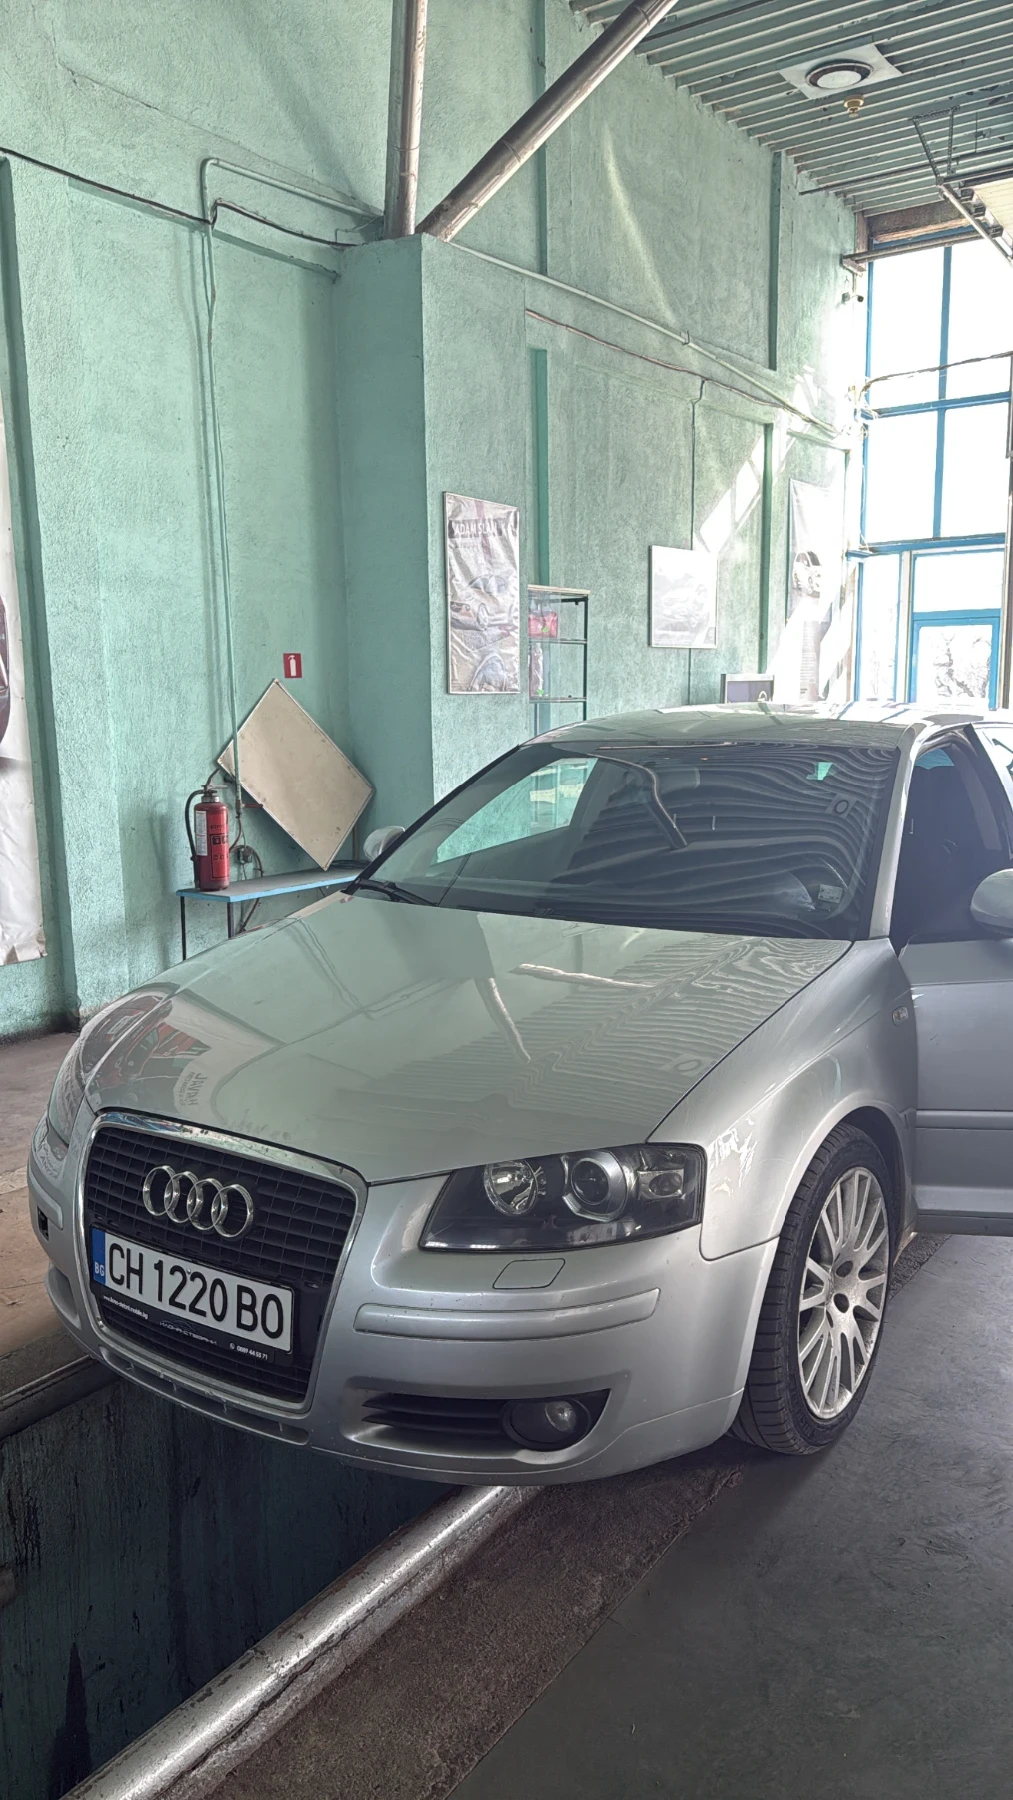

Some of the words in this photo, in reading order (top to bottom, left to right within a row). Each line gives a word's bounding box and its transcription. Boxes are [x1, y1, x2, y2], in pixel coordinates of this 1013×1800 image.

[94, 1261, 105, 1277] BG
[109, 1243, 144, 1295] CH
[154, 1259, 228, 1322] 1220
[236, 1284, 284, 1340] BO
